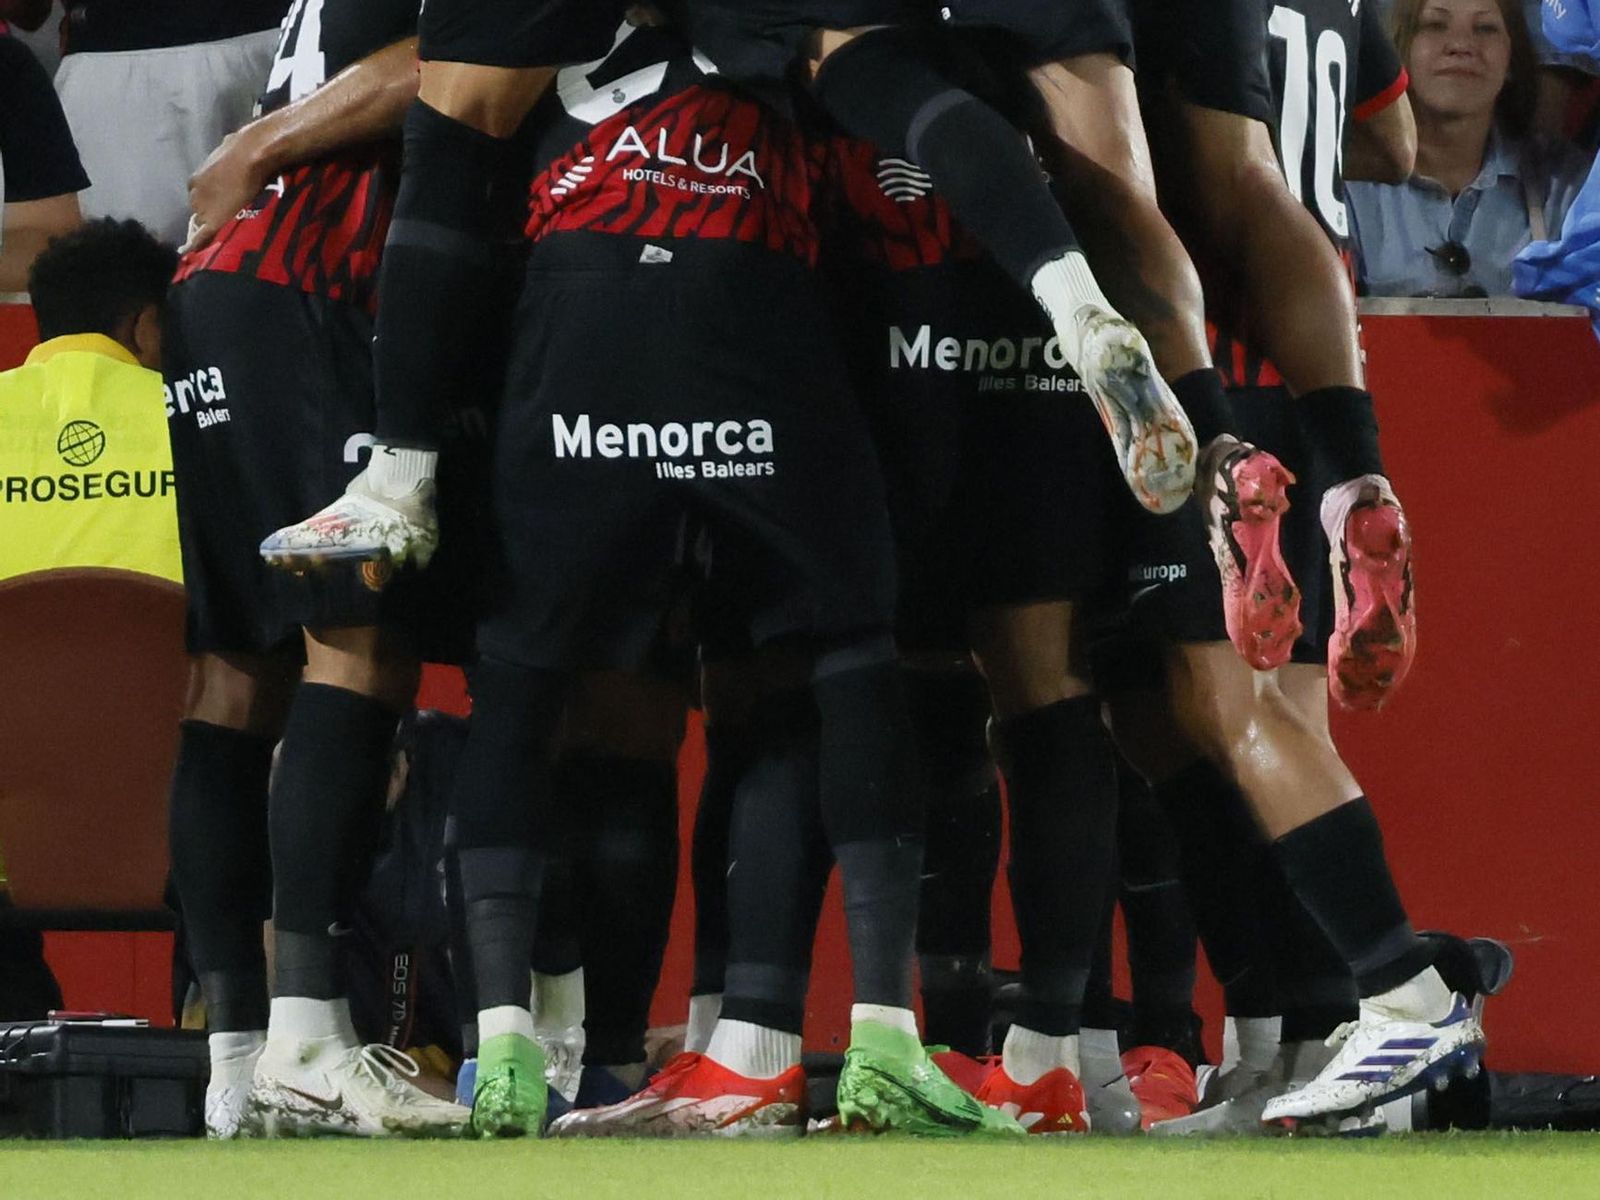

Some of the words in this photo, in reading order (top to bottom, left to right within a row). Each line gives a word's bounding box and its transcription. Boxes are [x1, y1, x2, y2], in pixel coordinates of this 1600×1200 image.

[1267, 5, 1349, 237] 10
[605, 125, 764, 189] ALUA
[622, 168, 675, 188] HOTELS
[677, 177, 688, 191] &
[690, 180, 751, 200] RESORTS
[889, 324, 1070, 372] Menorc
[552, 413, 775, 458] Menorca
[0, 470, 175, 503] ROSEGUR
[655, 461, 696, 479] Illes
[701, 460, 775, 478] Balears
[1137, 564, 1187, 582] uropa
[394, 953, 409, 995] EOS
